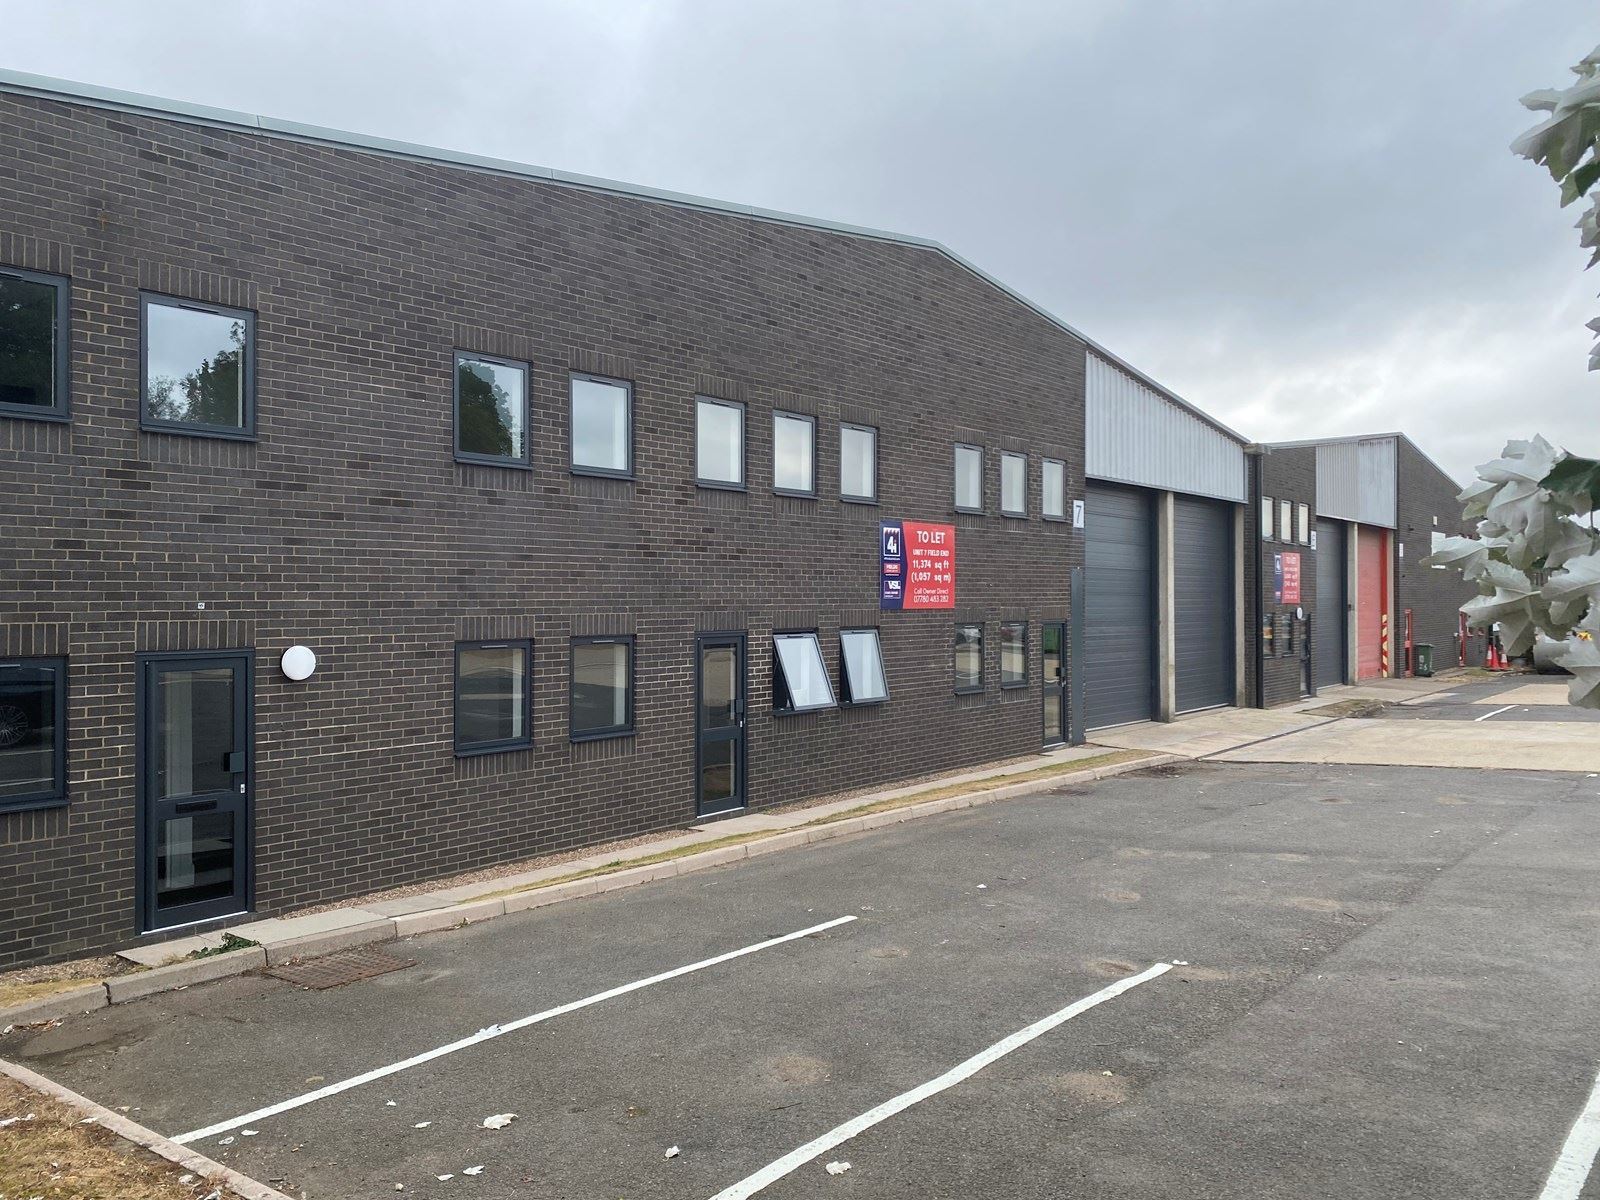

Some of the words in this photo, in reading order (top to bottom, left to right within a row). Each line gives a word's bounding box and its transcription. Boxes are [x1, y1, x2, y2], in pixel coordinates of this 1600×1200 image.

[1075, 504, 1082, 524] 7
[916, 530, 929, 543] TO
[931, 532, 945, 544] LET
[913, 559, 931, 570] 11,374
[934, 562, 942, 571] sq
[943, 559, 949, 569] ft
[911, 571, 931, 583] (1,057
[934, 574, 942, 583] sq
[943, 572, 951, 583] m)
